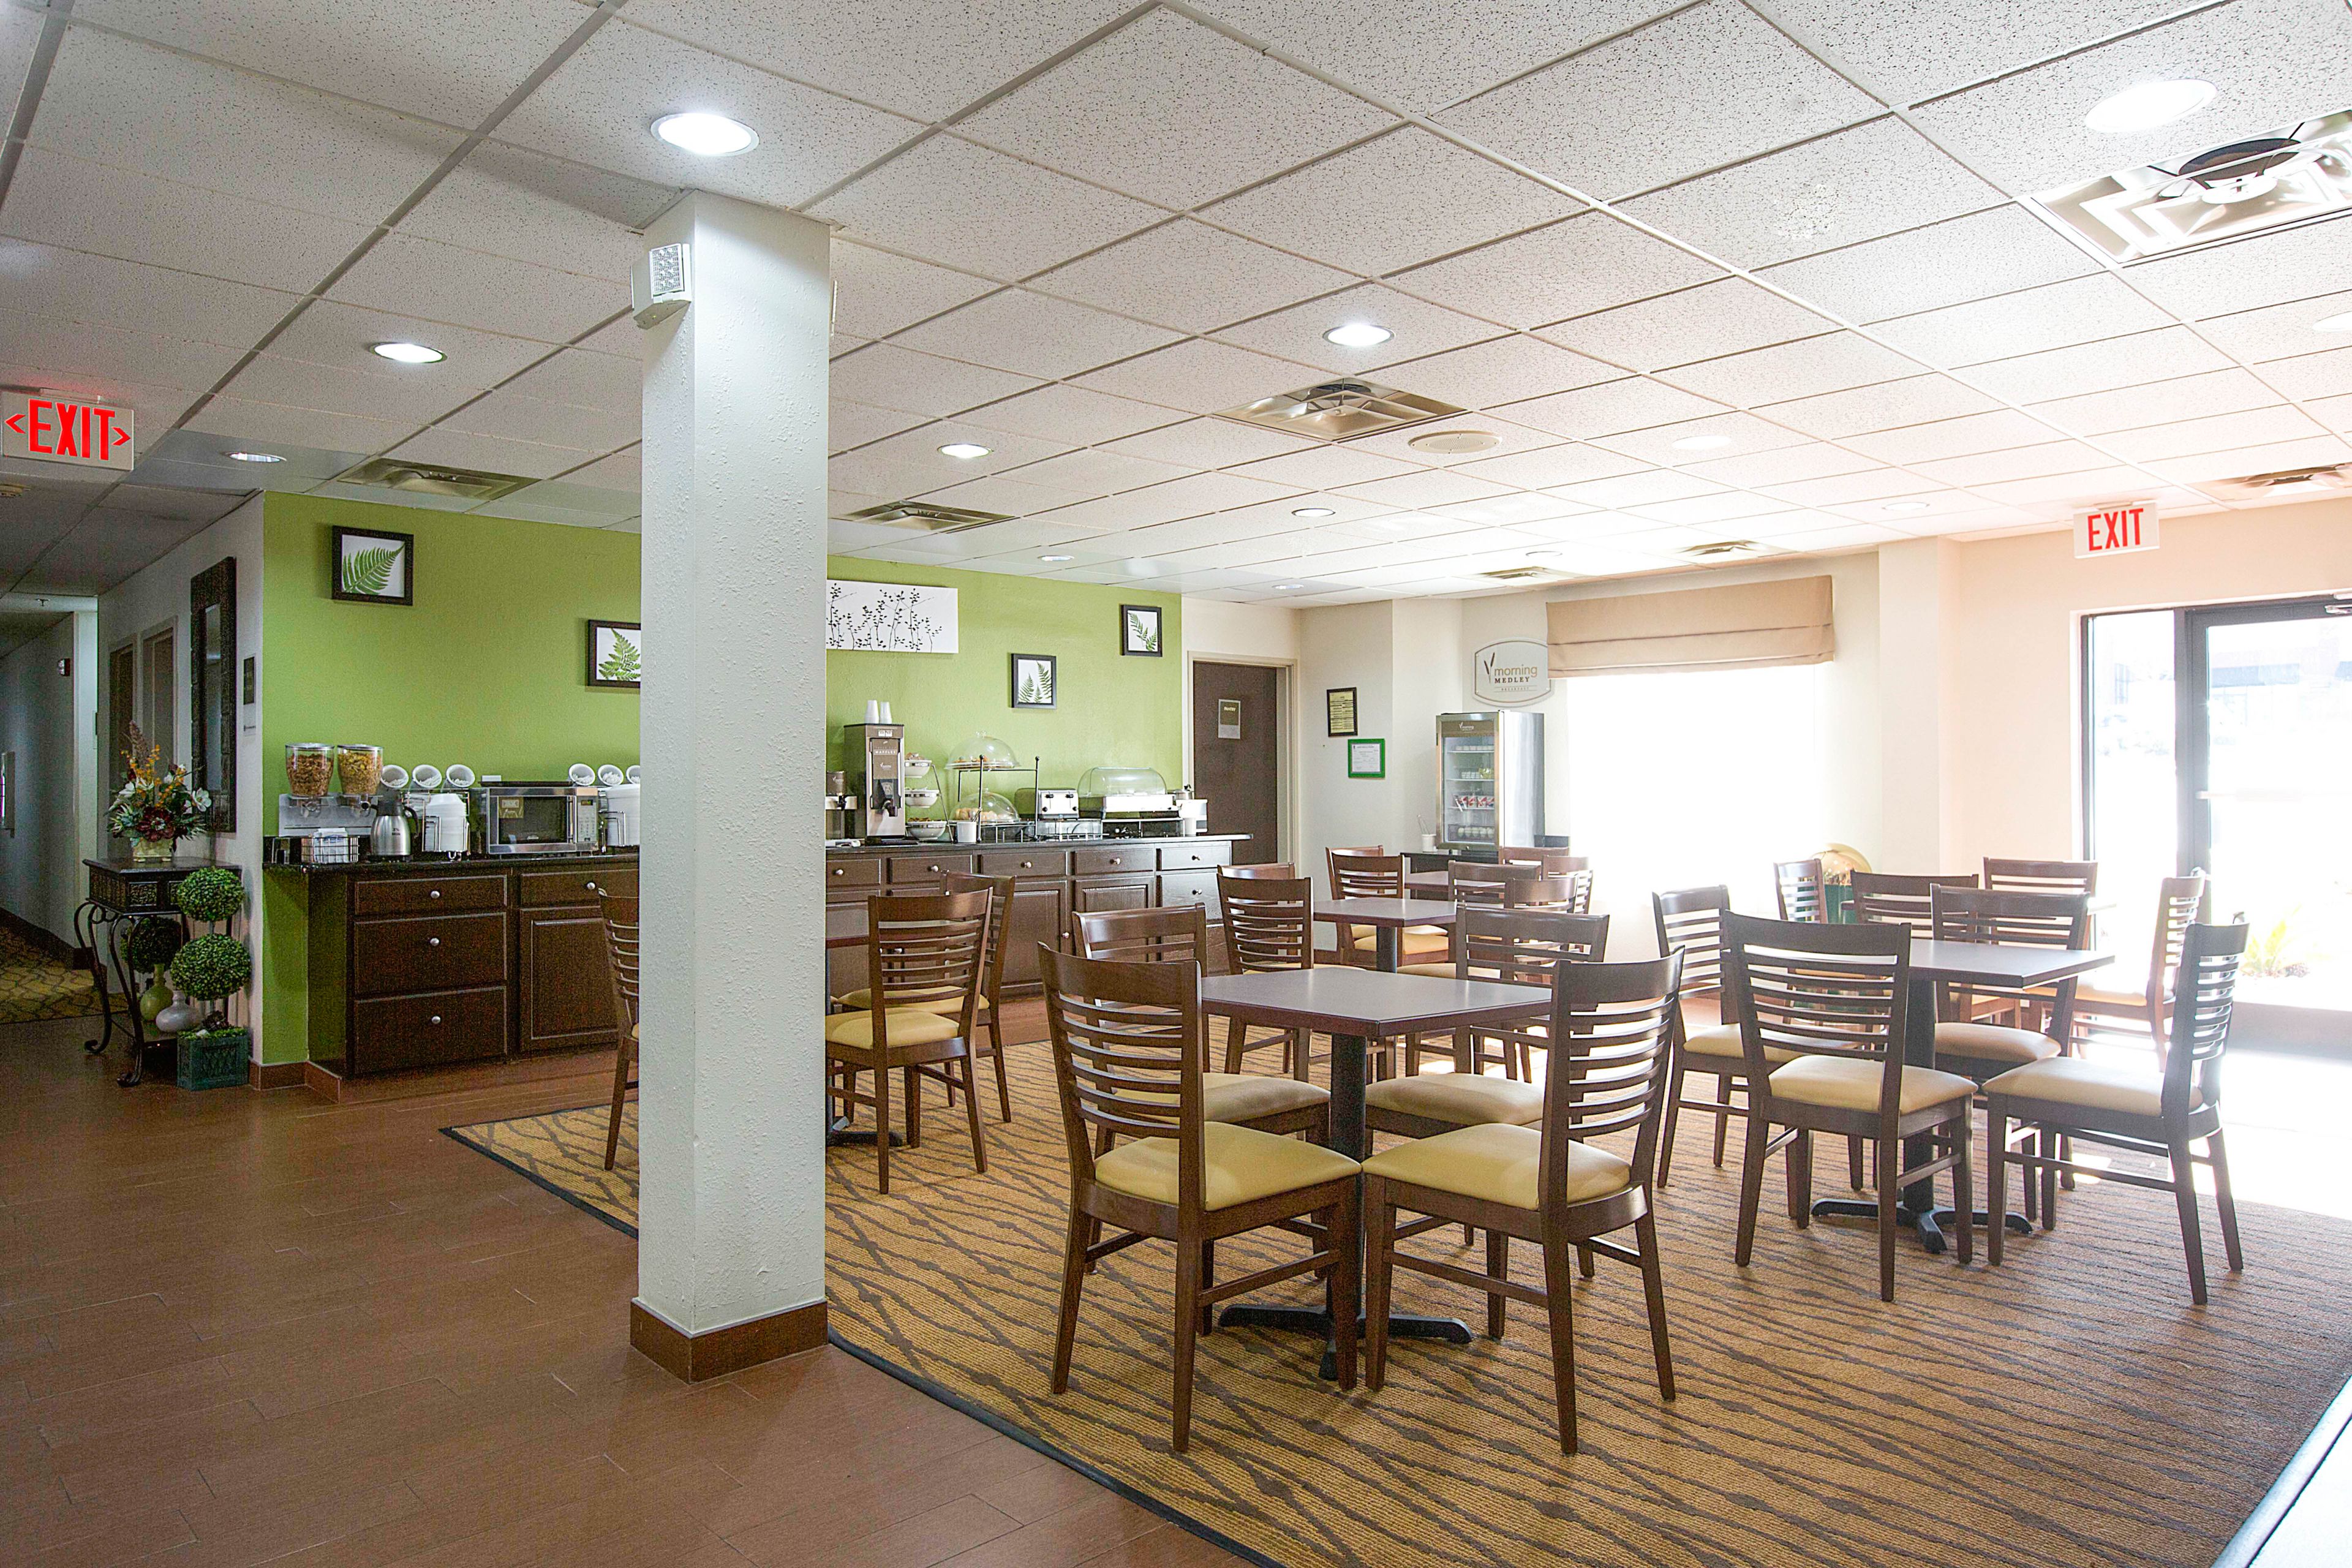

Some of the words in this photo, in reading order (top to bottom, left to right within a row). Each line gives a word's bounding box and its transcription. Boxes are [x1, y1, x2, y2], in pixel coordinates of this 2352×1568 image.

[28, 398, 116, 461] EXIT
[2087, 508, 2144, 551] EXIT
[1494, 664, 1537, 677] morning
